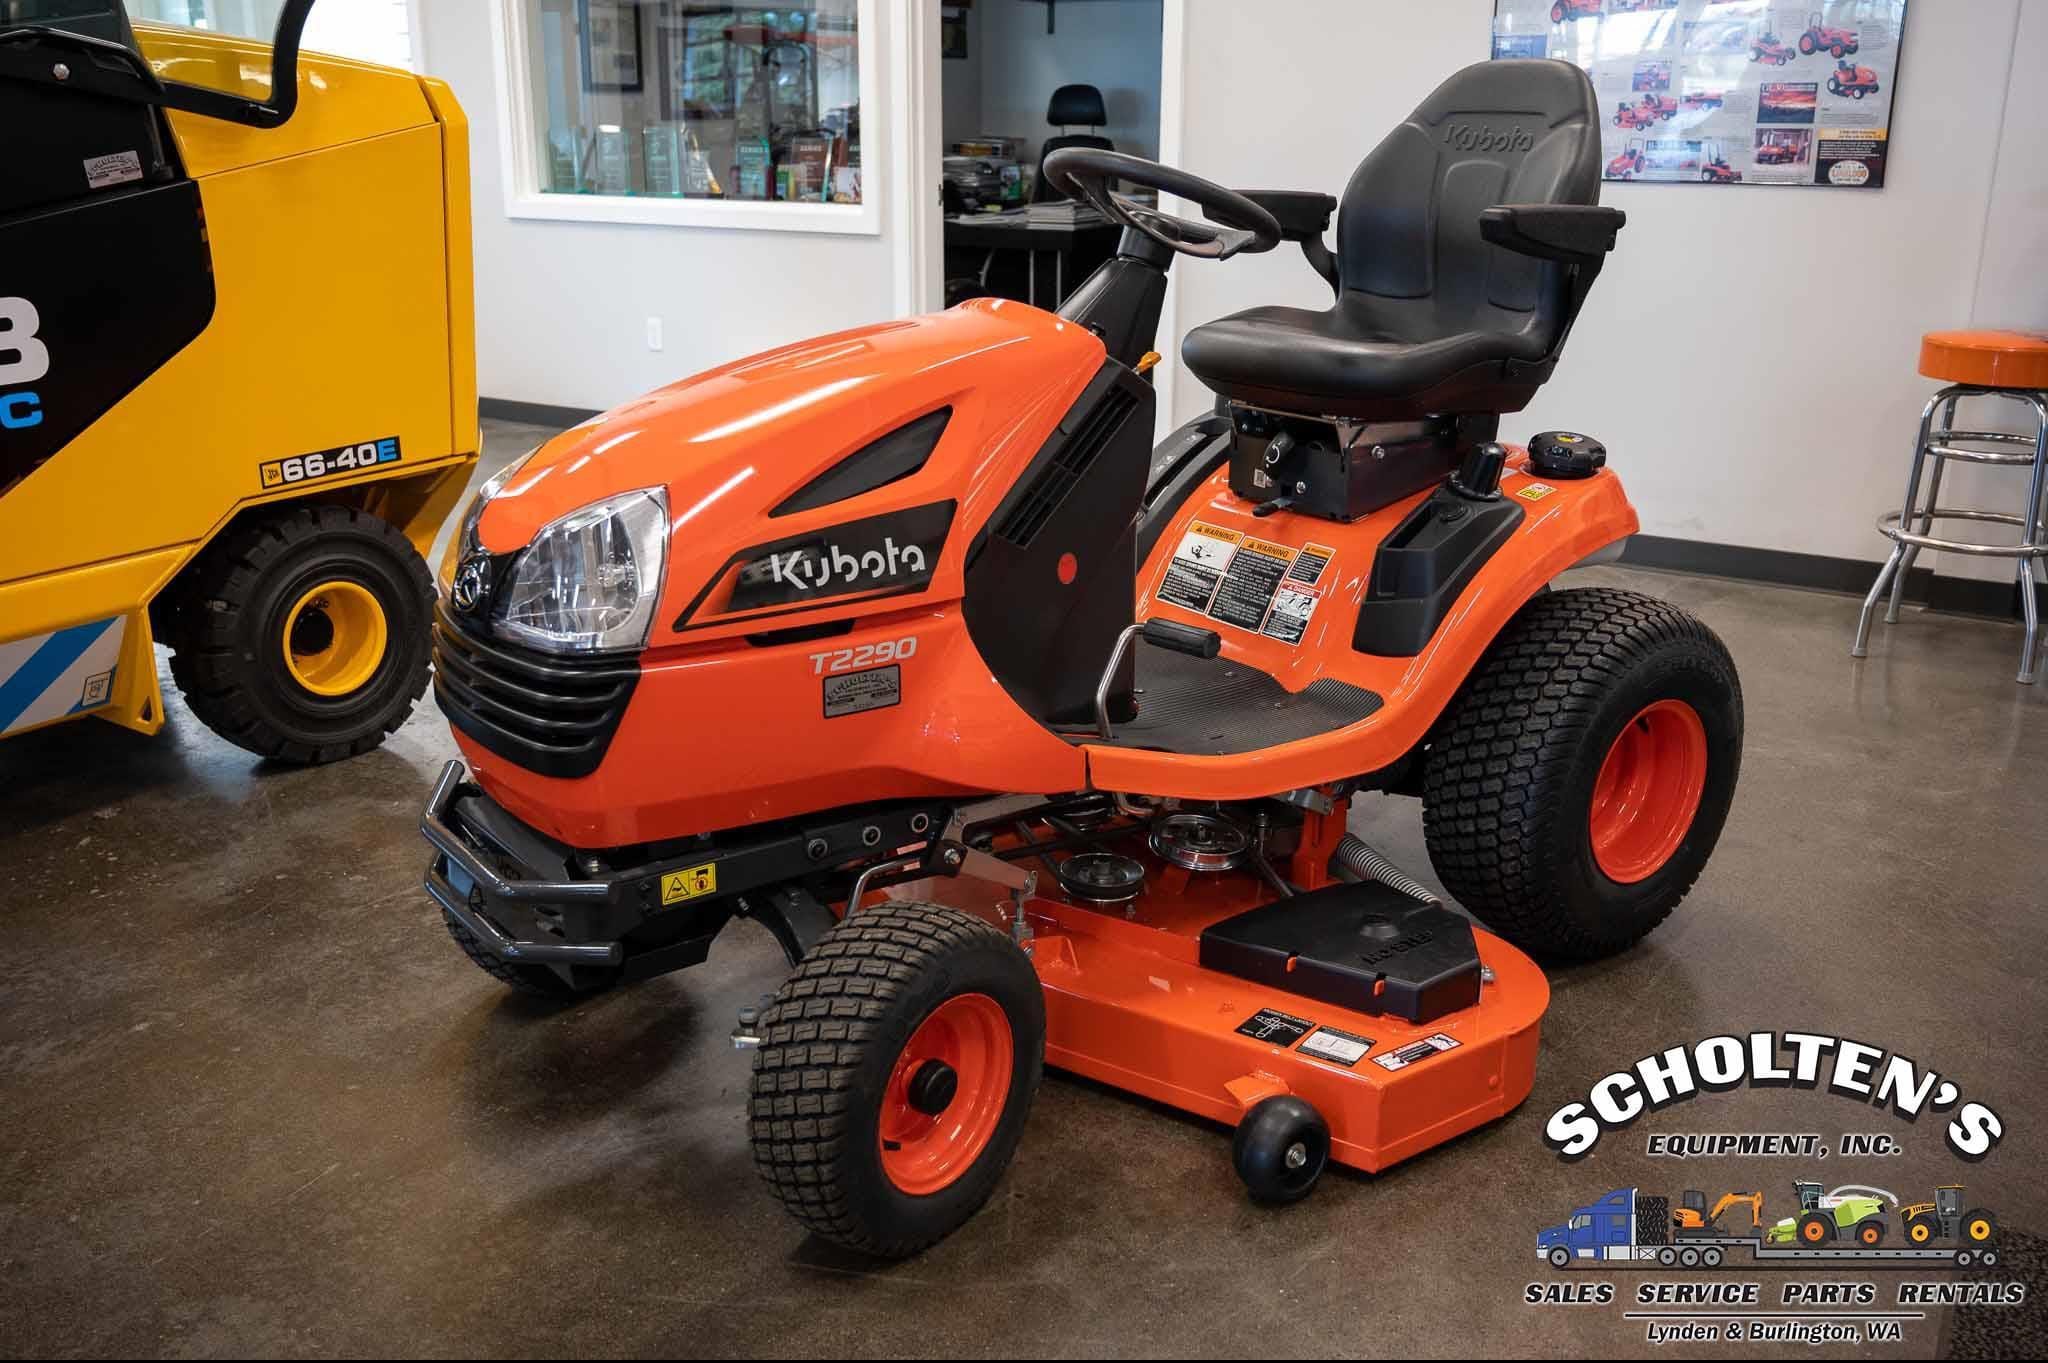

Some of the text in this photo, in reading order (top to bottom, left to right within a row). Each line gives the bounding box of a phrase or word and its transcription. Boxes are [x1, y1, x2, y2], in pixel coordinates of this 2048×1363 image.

[1442, 124, 1534, 152] Kubota
[282, 439, 397, 482] 66-40E
[1204, 526, 1235, 541] WARNING
[770, 537, 926, 590] Kubota
[1256, 543, 1290, 558] WARNING
[809, 636, 917, 675] T2290
